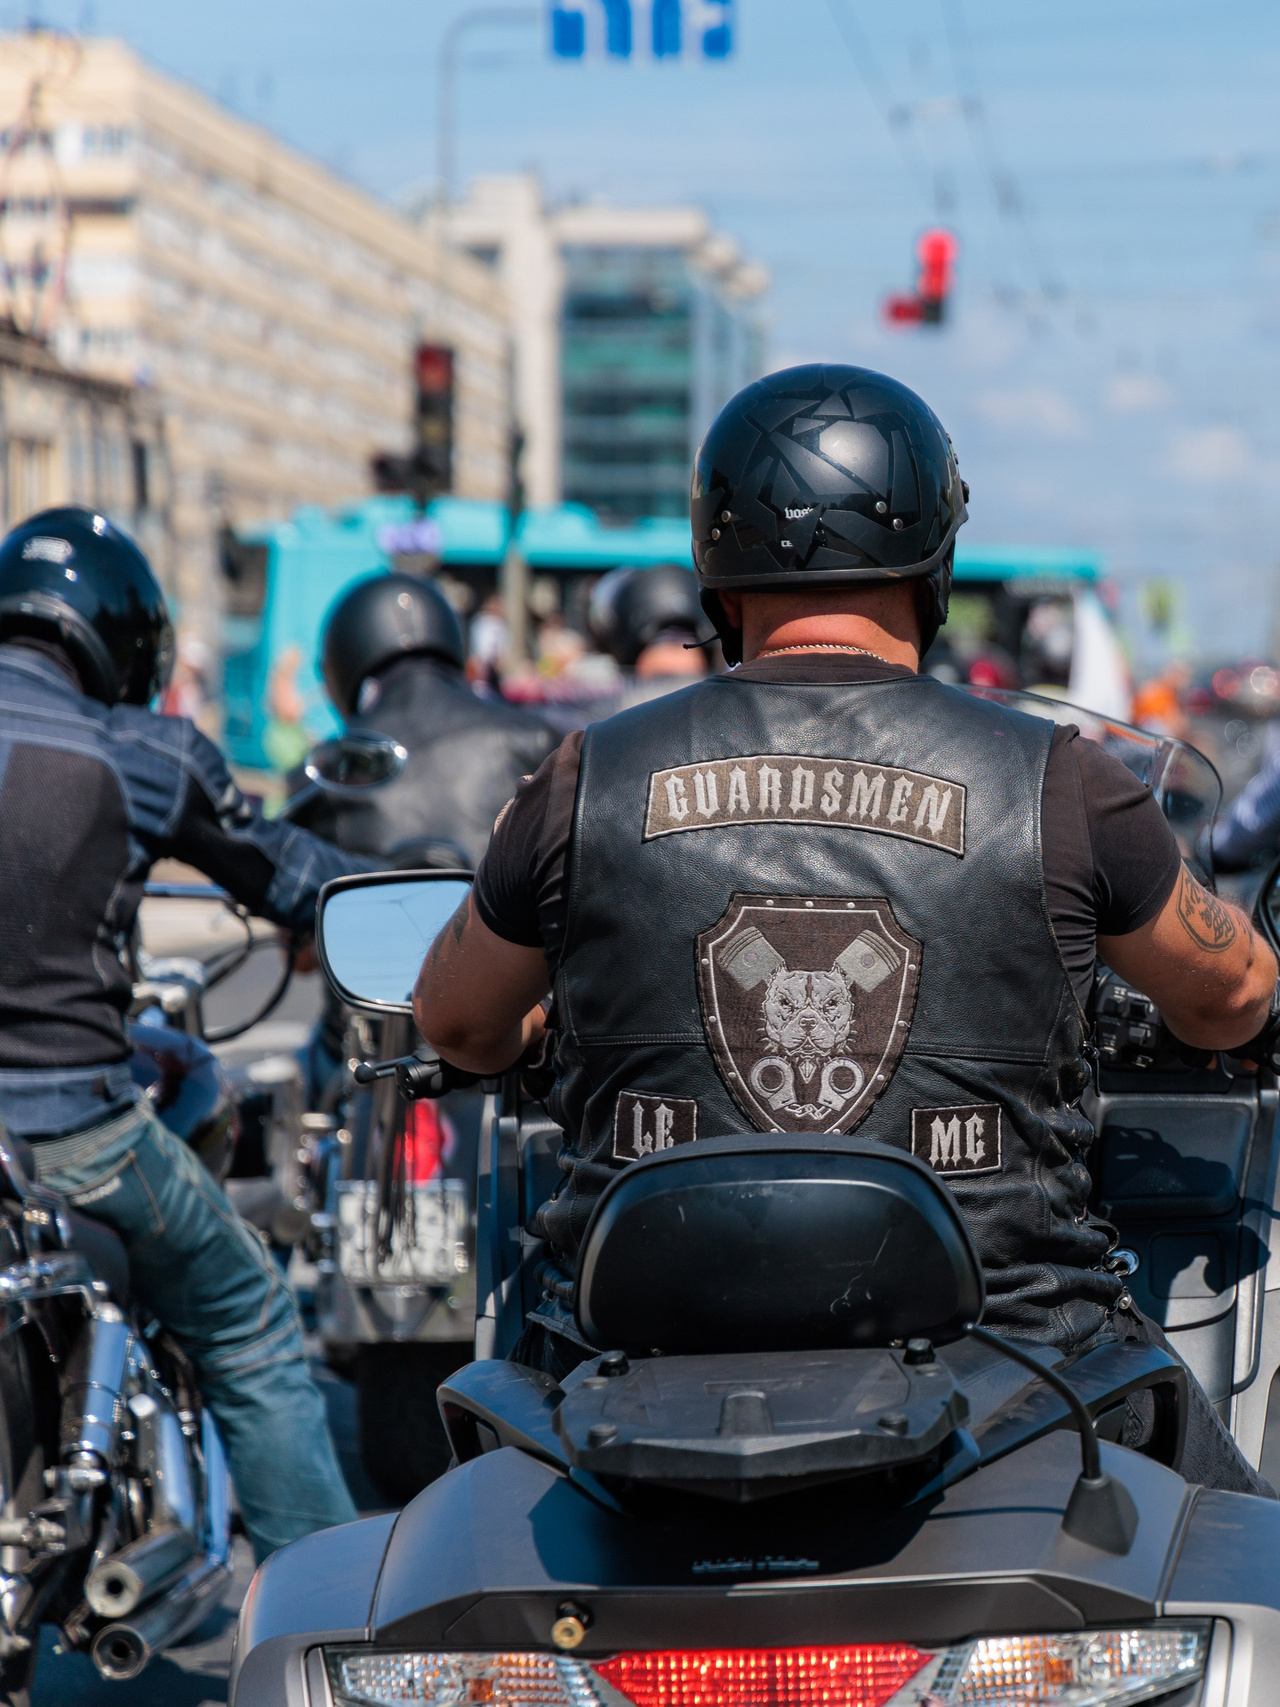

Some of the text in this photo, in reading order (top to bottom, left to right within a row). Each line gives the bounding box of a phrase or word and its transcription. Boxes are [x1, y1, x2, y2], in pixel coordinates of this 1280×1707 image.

[664, 763, 953, 836] GUARDSMEN
[631, 1099, 675, 1159] LE
[928, 1111, 986, 1169] MC
